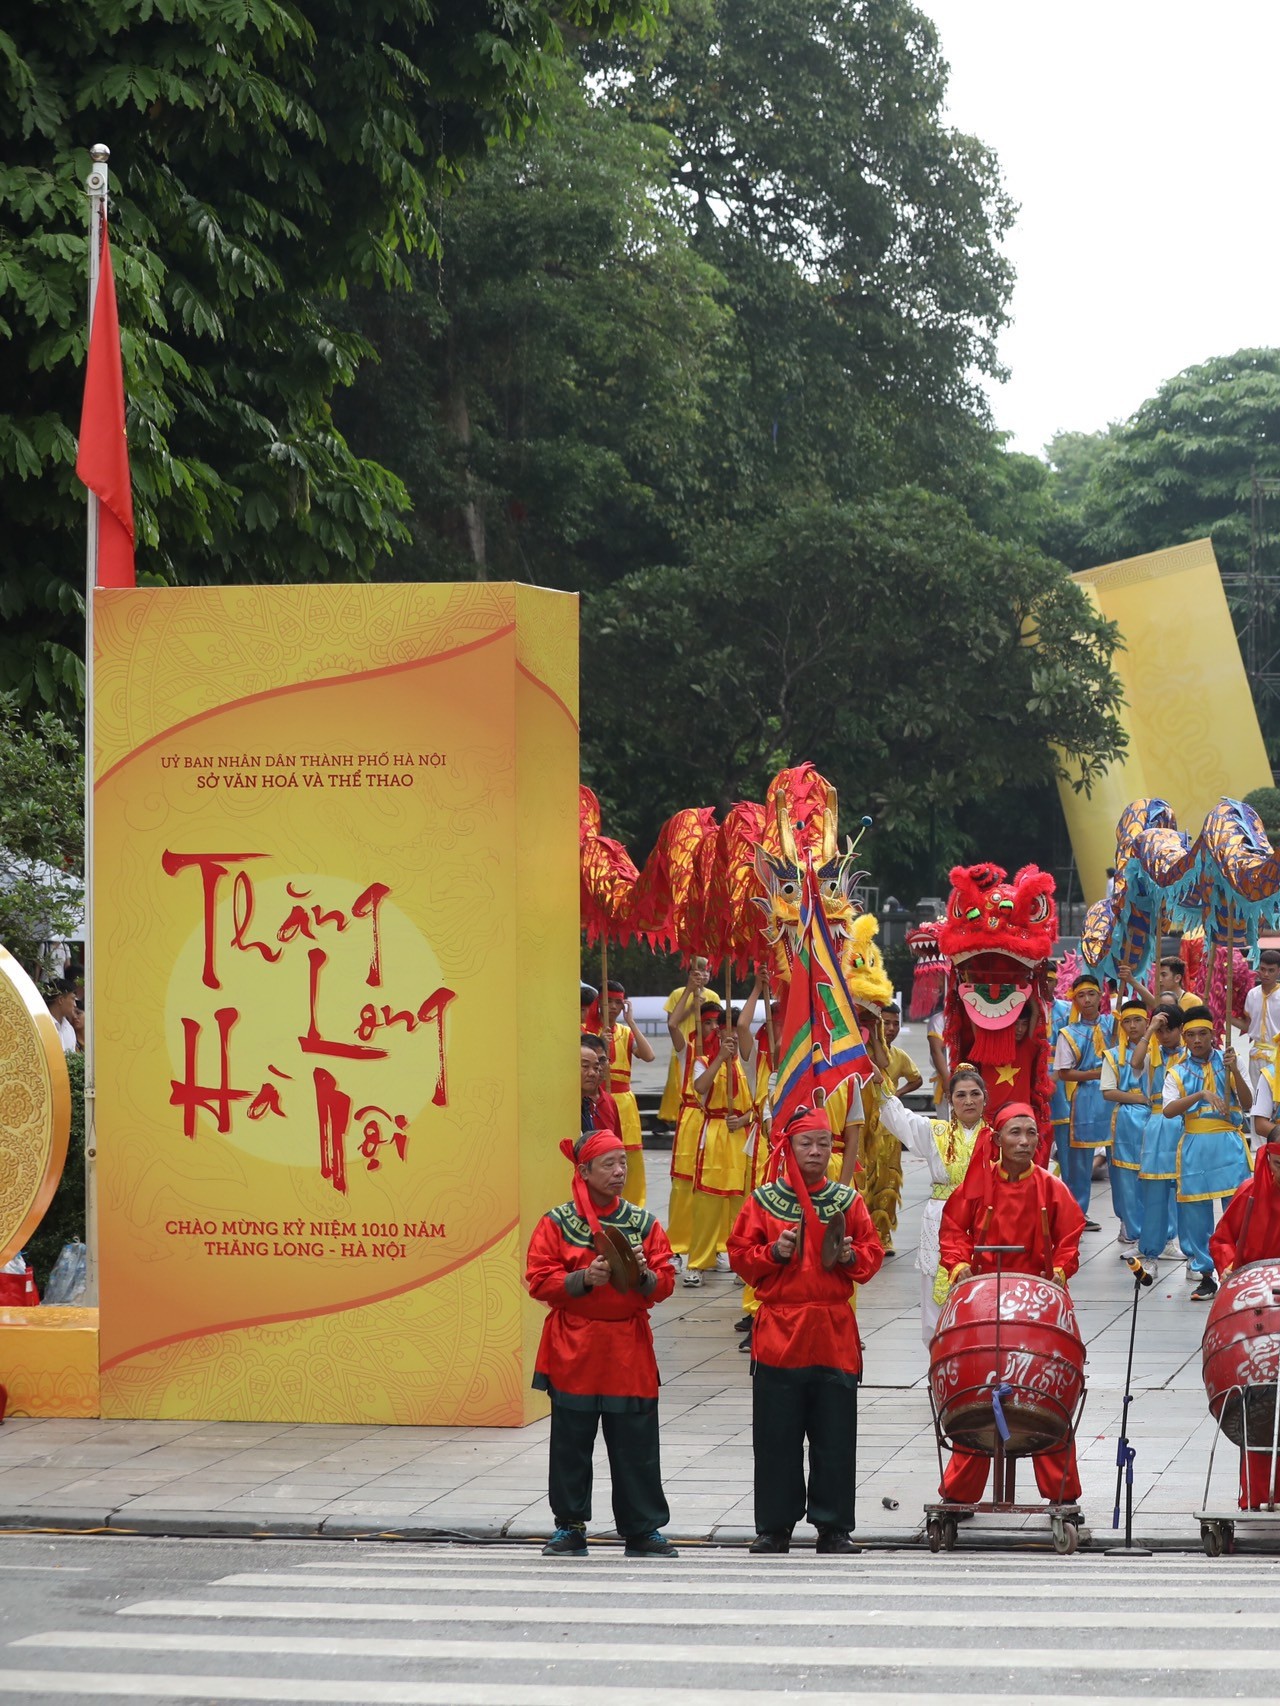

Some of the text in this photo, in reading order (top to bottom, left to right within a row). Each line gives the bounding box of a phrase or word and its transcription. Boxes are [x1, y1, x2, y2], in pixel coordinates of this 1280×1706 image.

[161, 750, 446, 769] UỶ BAN NHÂN DÂN THÀNH PHỐ HÀ NỘI
[196, 768, 414, 789] SỞ VĂN HOÁ VÀ THỂ THAO
[161, 848, 391, 990] Thăng
[298, 947, 457, 1106] Long
[169, 1006, 409, 1196] Hà Nội
[166, 1217, 217, 1235] CHÀO
[222, 1218, 279, 1237] MỪNG
[310, 1219, 358, 1240] NIỆM
[362, 1222, 399, 1237] 1010
[403, 1220, 446, 1238] NĂM
[204, 1239, 268, 1257] THĂNG
[273, 1242, 325, 1258] LONG
[341, 1239, 368, 1257] HÀ
[372, 1240, 407, 1260] NỘI
